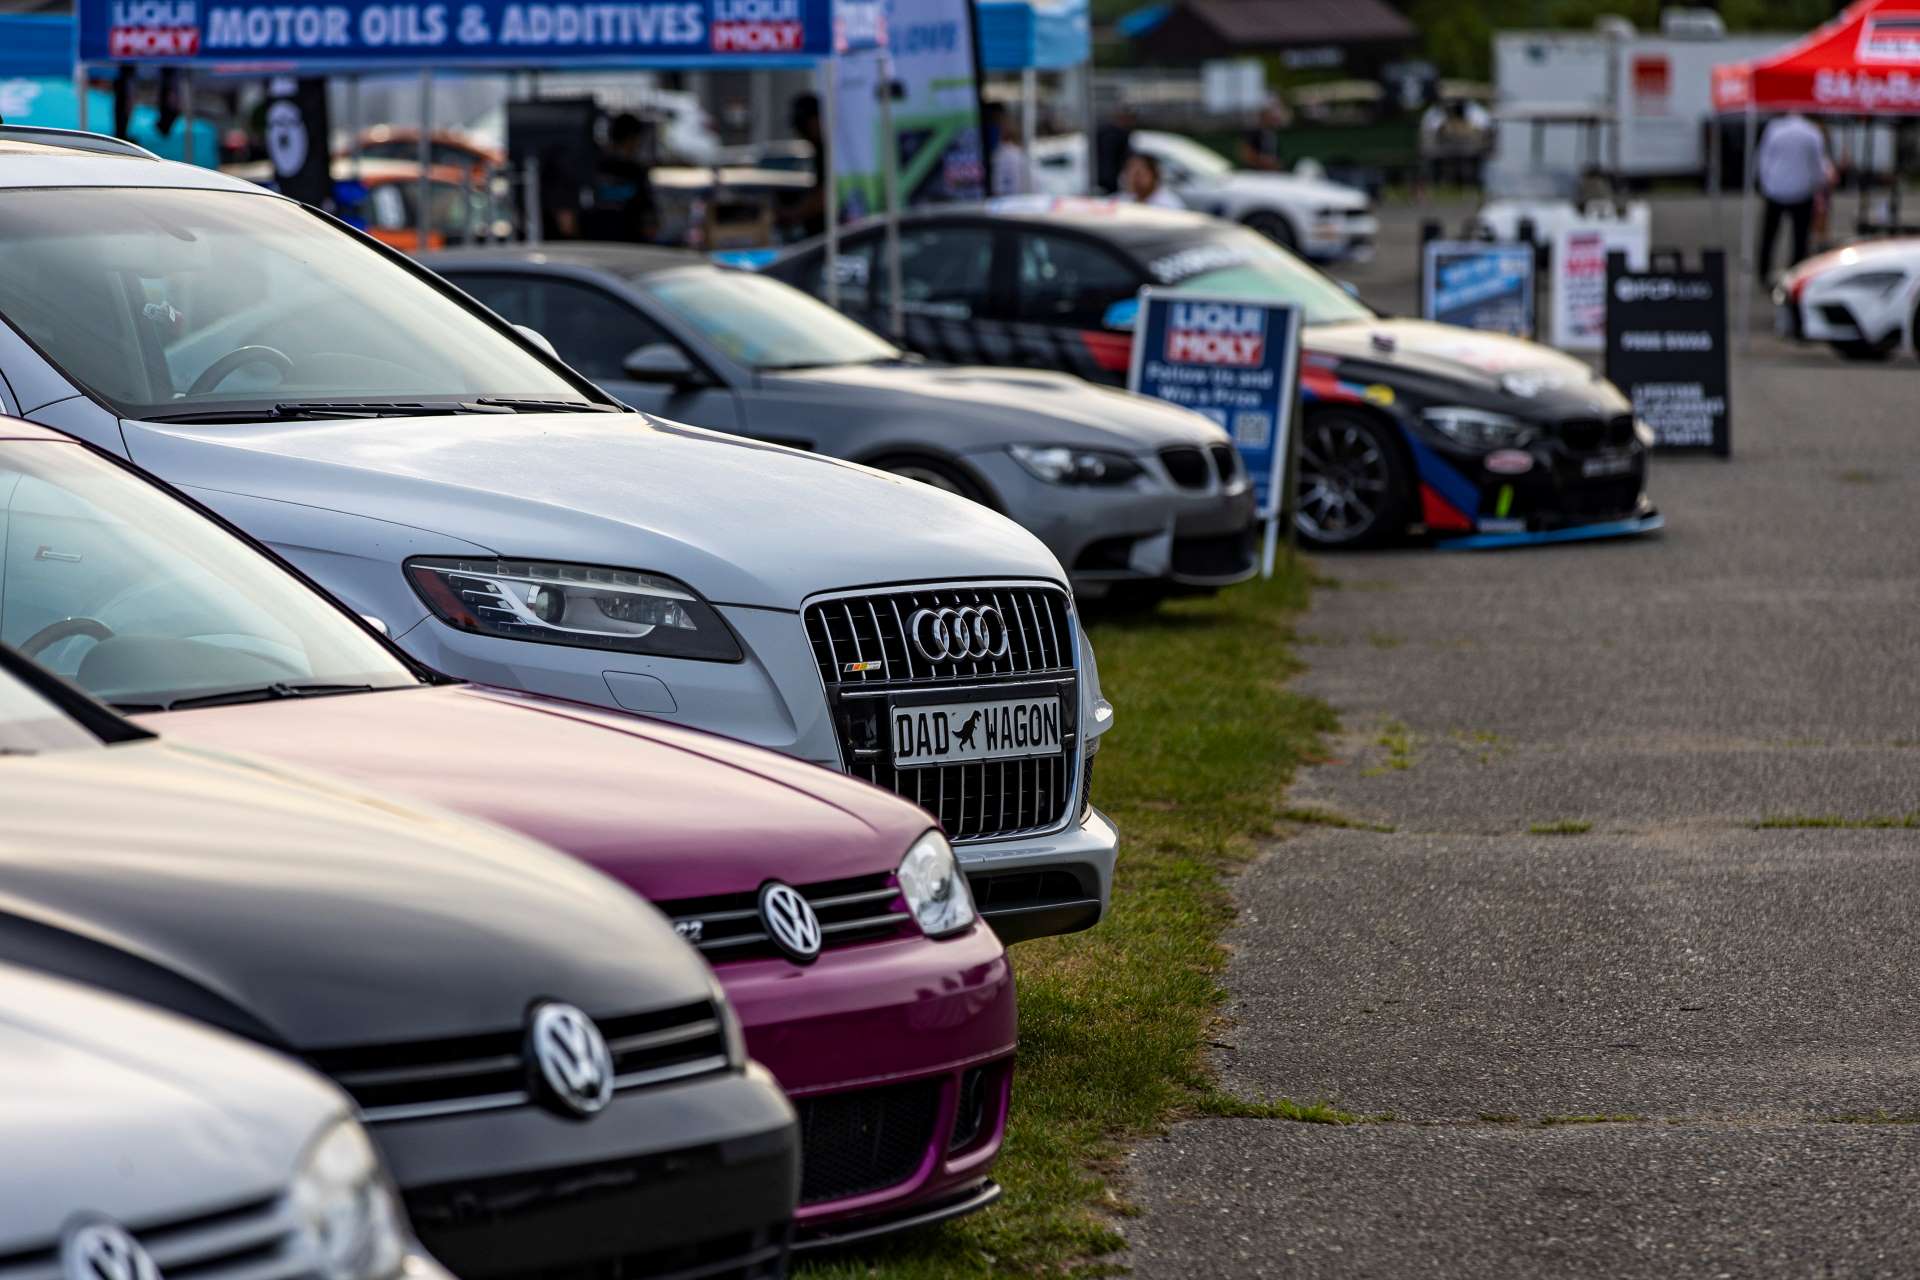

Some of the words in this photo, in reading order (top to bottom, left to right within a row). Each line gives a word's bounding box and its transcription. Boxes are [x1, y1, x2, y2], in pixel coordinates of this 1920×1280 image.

[112, 0, 197, 26] LIQUI
[207, 6, 349, 47] MOTOR
[361, 4, 449, 46] OILS
[456, 4, 491, 45] &
[500, 2, 703, 45] ADDITIVES
[713, 0, 800, 21] LIQUI
[111, 28, 199, 55] MOLY
[711, 22, 802, 50] MOLY
[1171, 302, 1264, 332] LIQUI
[1168, 333, 1263, 363] MOLY
[1239, 369, 1273, 390] and
[895, 711, 950, 758] DAD
[984, 701, 1059, 751] WAGON
